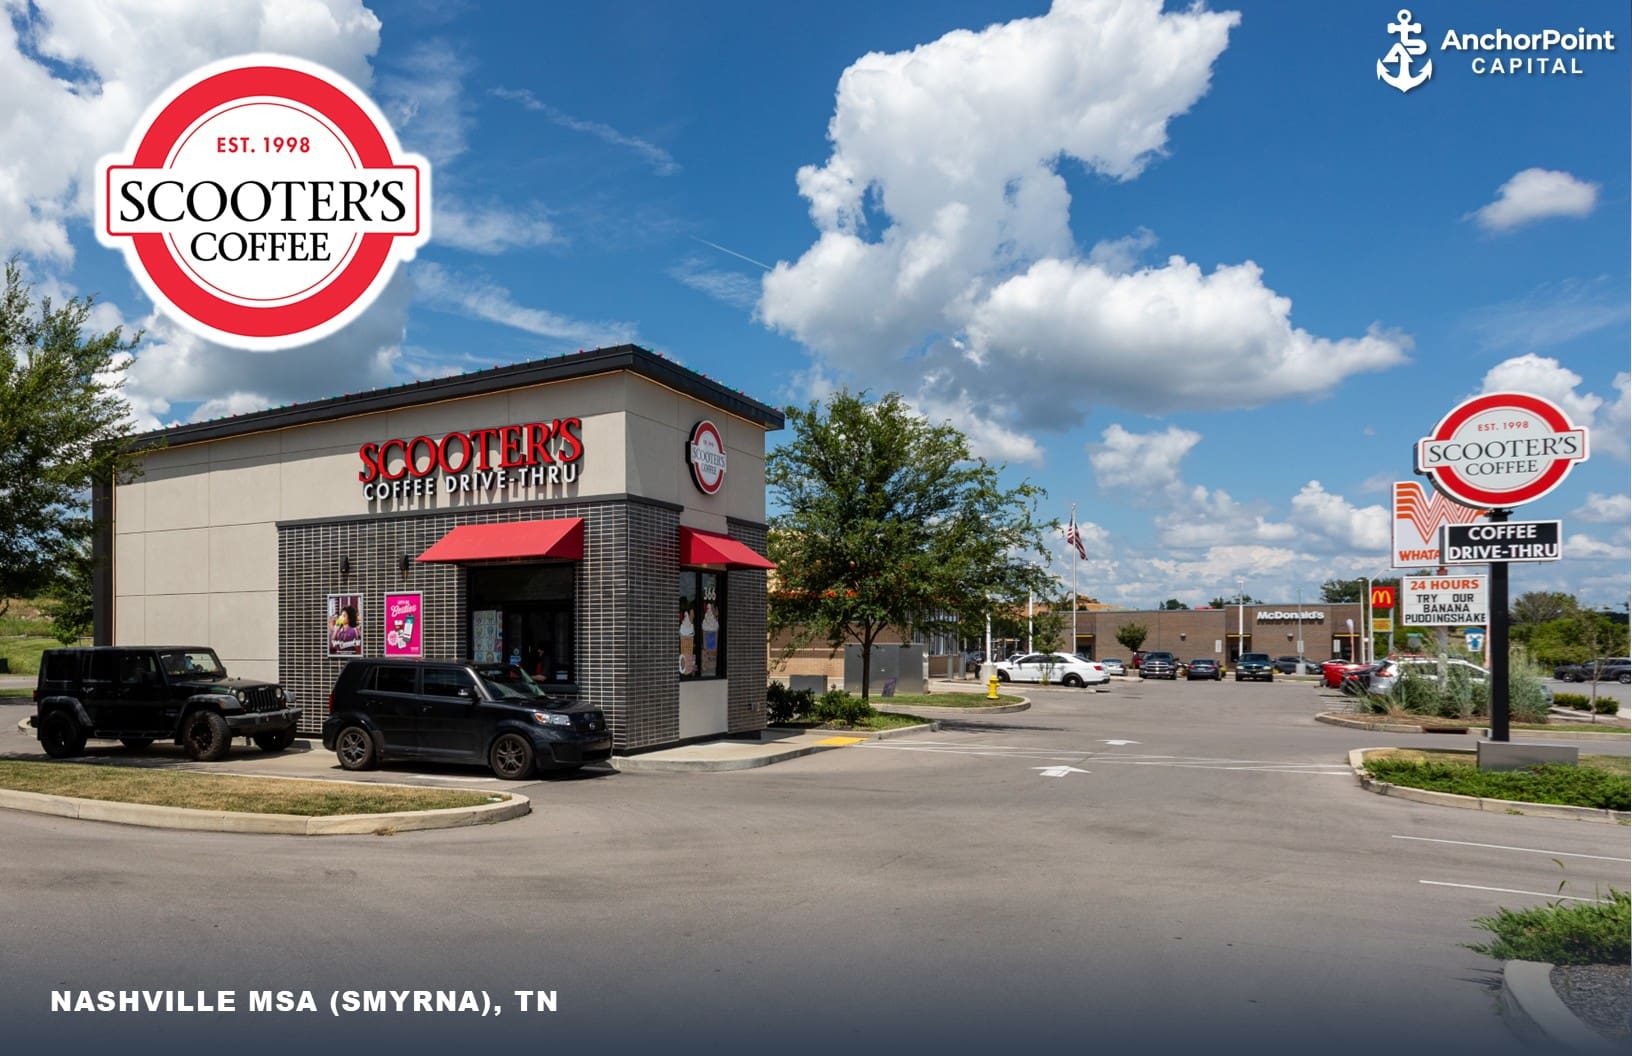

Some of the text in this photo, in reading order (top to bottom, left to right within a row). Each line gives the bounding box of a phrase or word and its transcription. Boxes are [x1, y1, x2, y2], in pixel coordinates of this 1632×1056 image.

[1477, 420, 1530, 432] EST. 1998
[358, 417, 583, 483] SCOOTER'S
[1428, 435, 1578, 463] SCOOTER'S
[1465, 459, 1539, 476] COFFEE
[363, 463, 577, 500] COFFEE DRIVE-THRU
[1468, 525, 1537, 541] COFFEE
[1449, 543, 1558, 560] DRIVE-THRU
[1410, 579, 1480, 591] 24 HOURS
[703, 586, 717, 600] 366
[1416, 593, 1474, 603] TRY OUR
[1257, 611, 1325, 620] McDonald's
[1423, 604, 1470, 613] BANANA
[1405, 613, 1486, 623] PUDDINGSHAKE
